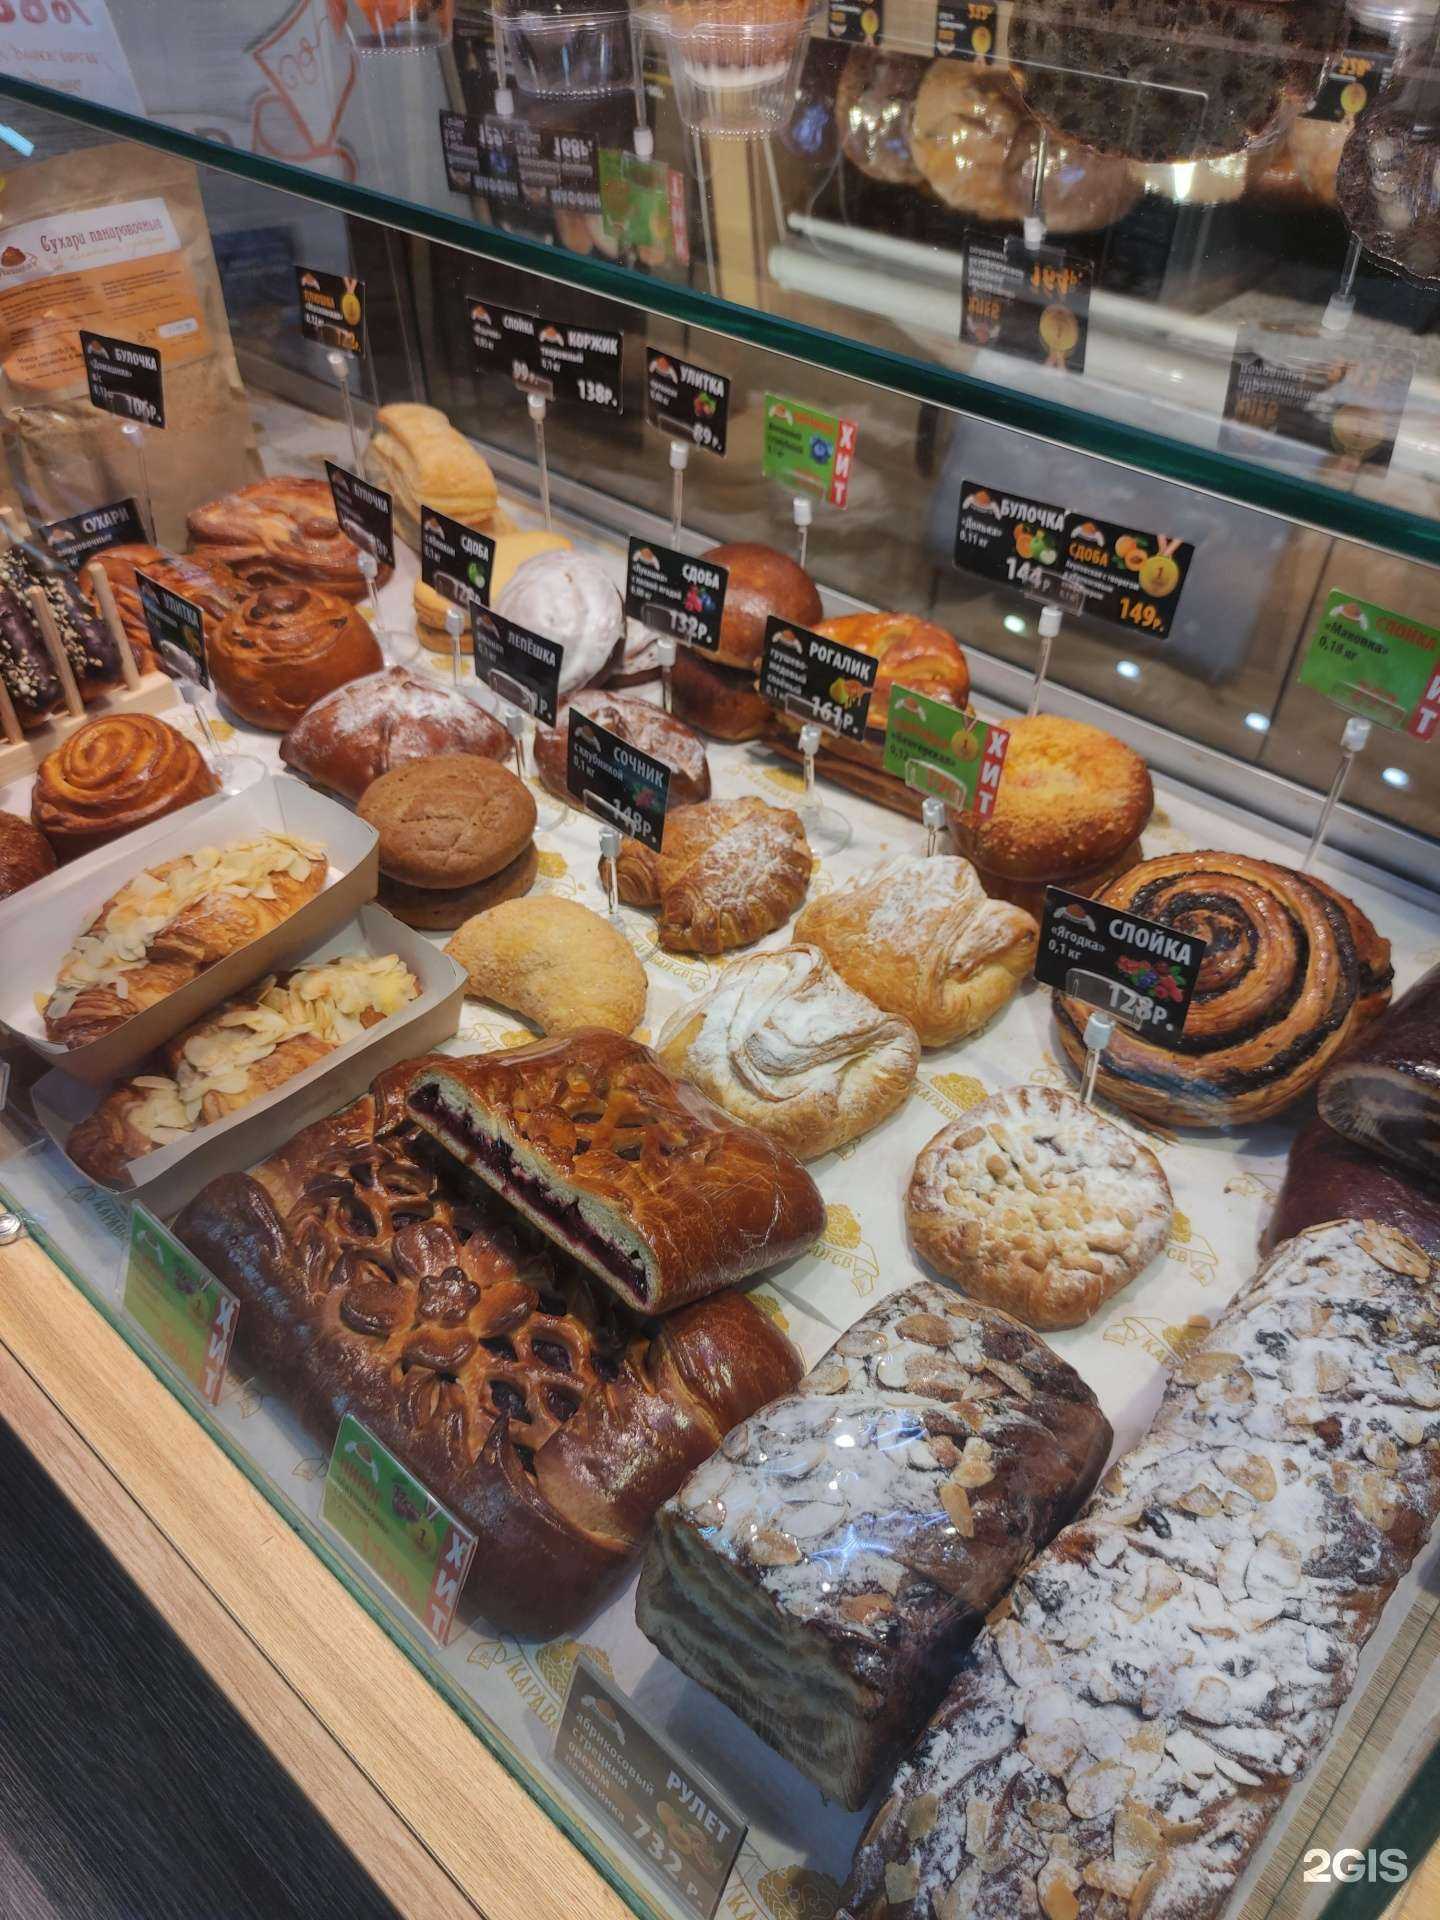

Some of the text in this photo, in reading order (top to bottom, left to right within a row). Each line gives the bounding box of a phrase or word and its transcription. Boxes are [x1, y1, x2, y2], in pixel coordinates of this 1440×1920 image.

[40, 232, 85, 254] Сухари
[114, 348, 158, 371] БУЛОЧКА
[568, 331, 618, 356] КОРЖИК
[680, 365, 724, 398] УЛИТКА
[835, 423, 853, 504] ХИТ
[83, 507, 129, 533] СУХАРИ
[1001, 498, 1064, 532] БУЛОЧКА
[461, 533, 489, 562] СДОБА
[1069, 543, 1109, 567] СДОБА
[682, 564, 720, 589] СДОБА
[508, 631, 556, 667] ЛЕПЁШКА
[809, 641, 871, 682] РОГАЛИК
[613, 747, 664, 789] СОЧНИК
[979, 731, 1010, 814] ХИТ
[1048, 939, 1083, 961] 0,1 кг
[1051, 925, 1106, 953] «Ягодка»
[1108, 918, 1192, 966] СЛОЙКА
[1109, 981, 1175, 1032] 128Р.
[431, 1532, 468, 1635] ХИТ
[568, 1741, 610, 1789] орехом
[576, 1713, 656, 1797] абрикосовый
[666, 1769, 731, 1844] РУЛЕТ
